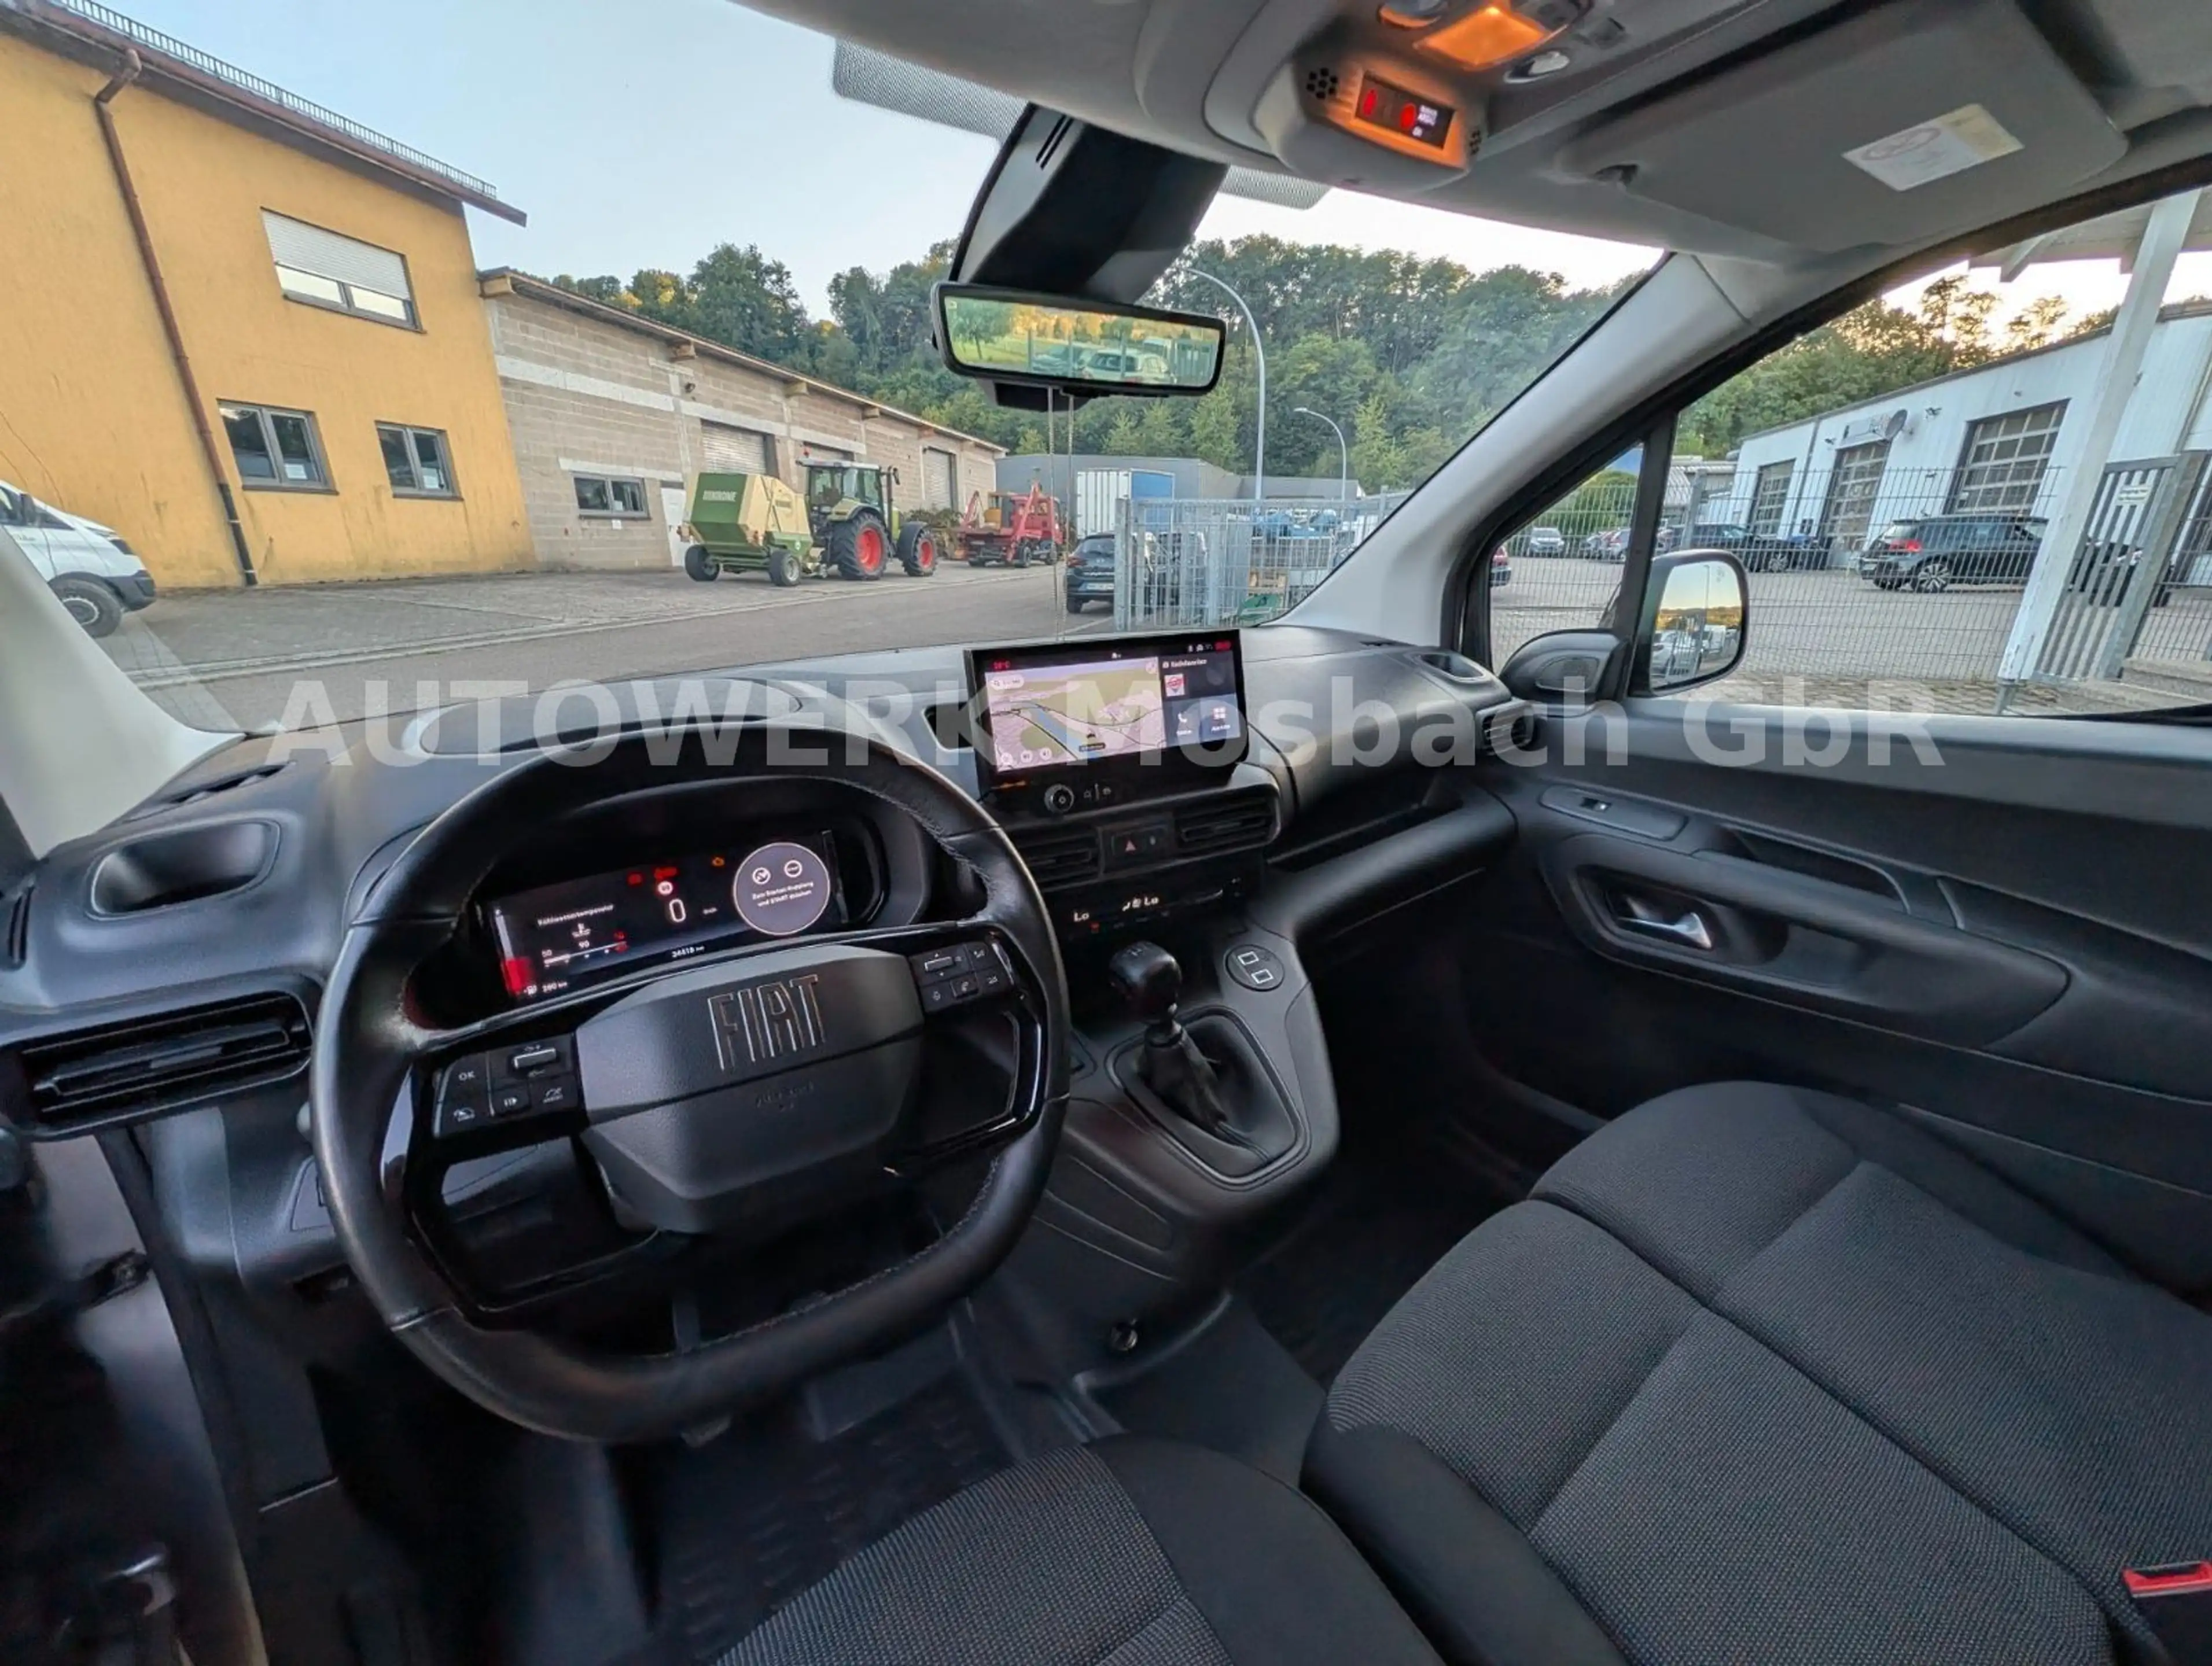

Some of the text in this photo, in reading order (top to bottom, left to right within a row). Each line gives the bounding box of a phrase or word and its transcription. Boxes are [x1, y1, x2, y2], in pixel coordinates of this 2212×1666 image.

[669, 898, 686, 923] 0
[707, 974, 826, 1071] FIAT
[458, 1071, 476, 1081] OK
